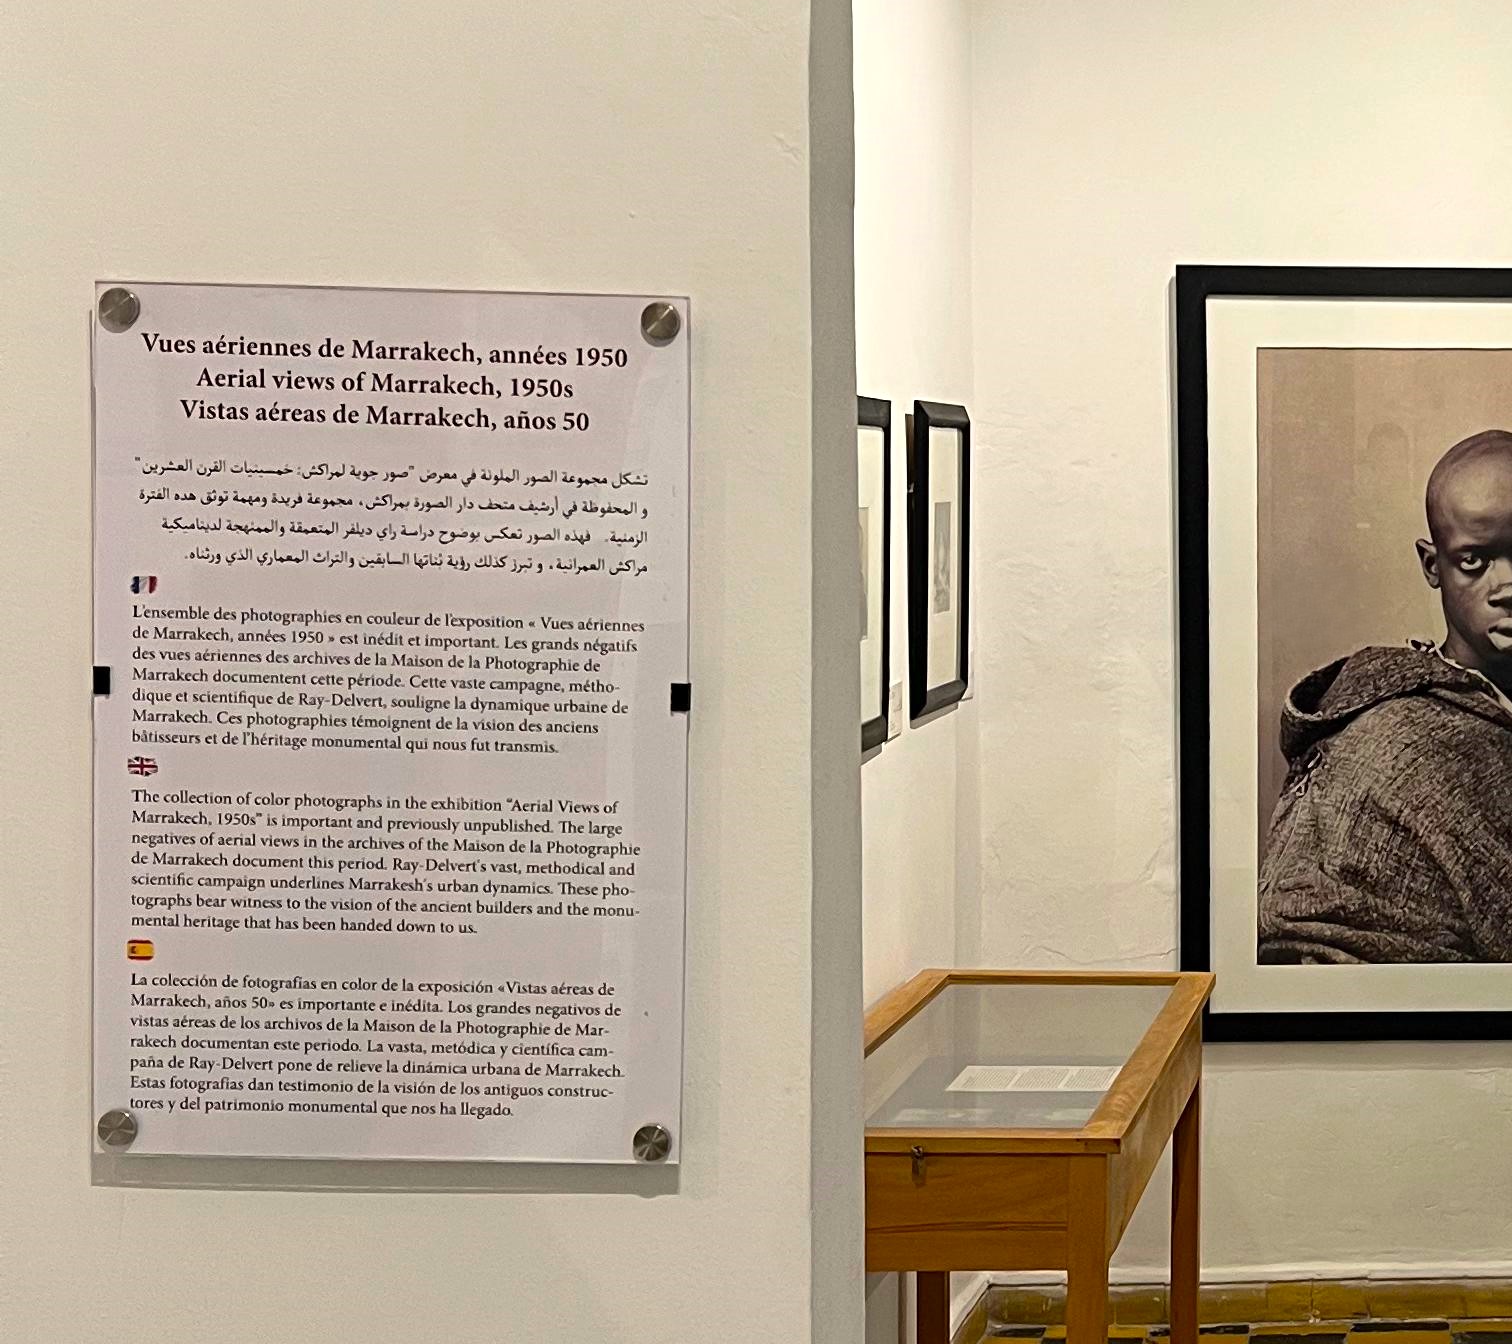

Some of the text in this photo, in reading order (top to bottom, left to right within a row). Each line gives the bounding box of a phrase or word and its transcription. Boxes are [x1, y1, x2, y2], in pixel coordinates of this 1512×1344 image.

[139, 332, 628, 368] Vues aériennes de Marrakech, années 1950
[195, 366, 573, 400] Aerial views of Marrakech, 1950s
[179, 399, 589, 432] Vistas aéreas de Marrakech, años 50
[132, 625, 638, 657] de Marrakech, années 1950 est inédit et important. Les grands négatifs
[131, 645, 600, 675] des vues aériennes des archives de la Maison de la Photographie de
[131, 667, 620, 696] Marrakech documentent cette période. Cette vaste campagne, métho-
[131, 708, 599, 734] Marrakech. Ces photographies témoignent de la vision des anciens
[131, 831, 641, 860] negatives of aerial views in the archives of the Maison de la Photographie
[130, 893, 640, 917] tographs bear witness to the vision of the ancient builders and the monu-
[131, 914, 478, 934] mental heritage that has been handed down to us.
[130, 1033, 177, 1048] rakech
[180, 1034, 269, 1050] documentan
[273, 1040, 300, 1051] este
[366, 1039, 384, 1053] La
[387, 1042, 427, 1055] vasta,
[430, 1040, 496, 1055] metódica
[499, 1045, 508, 1060] y
[511, 1042, 575, 1057] científica
[578, 1047, 614, 1058] cam-
[129, 1075, 614, 1101] Estas dan testimonio de la visión de los antiguos construc-
